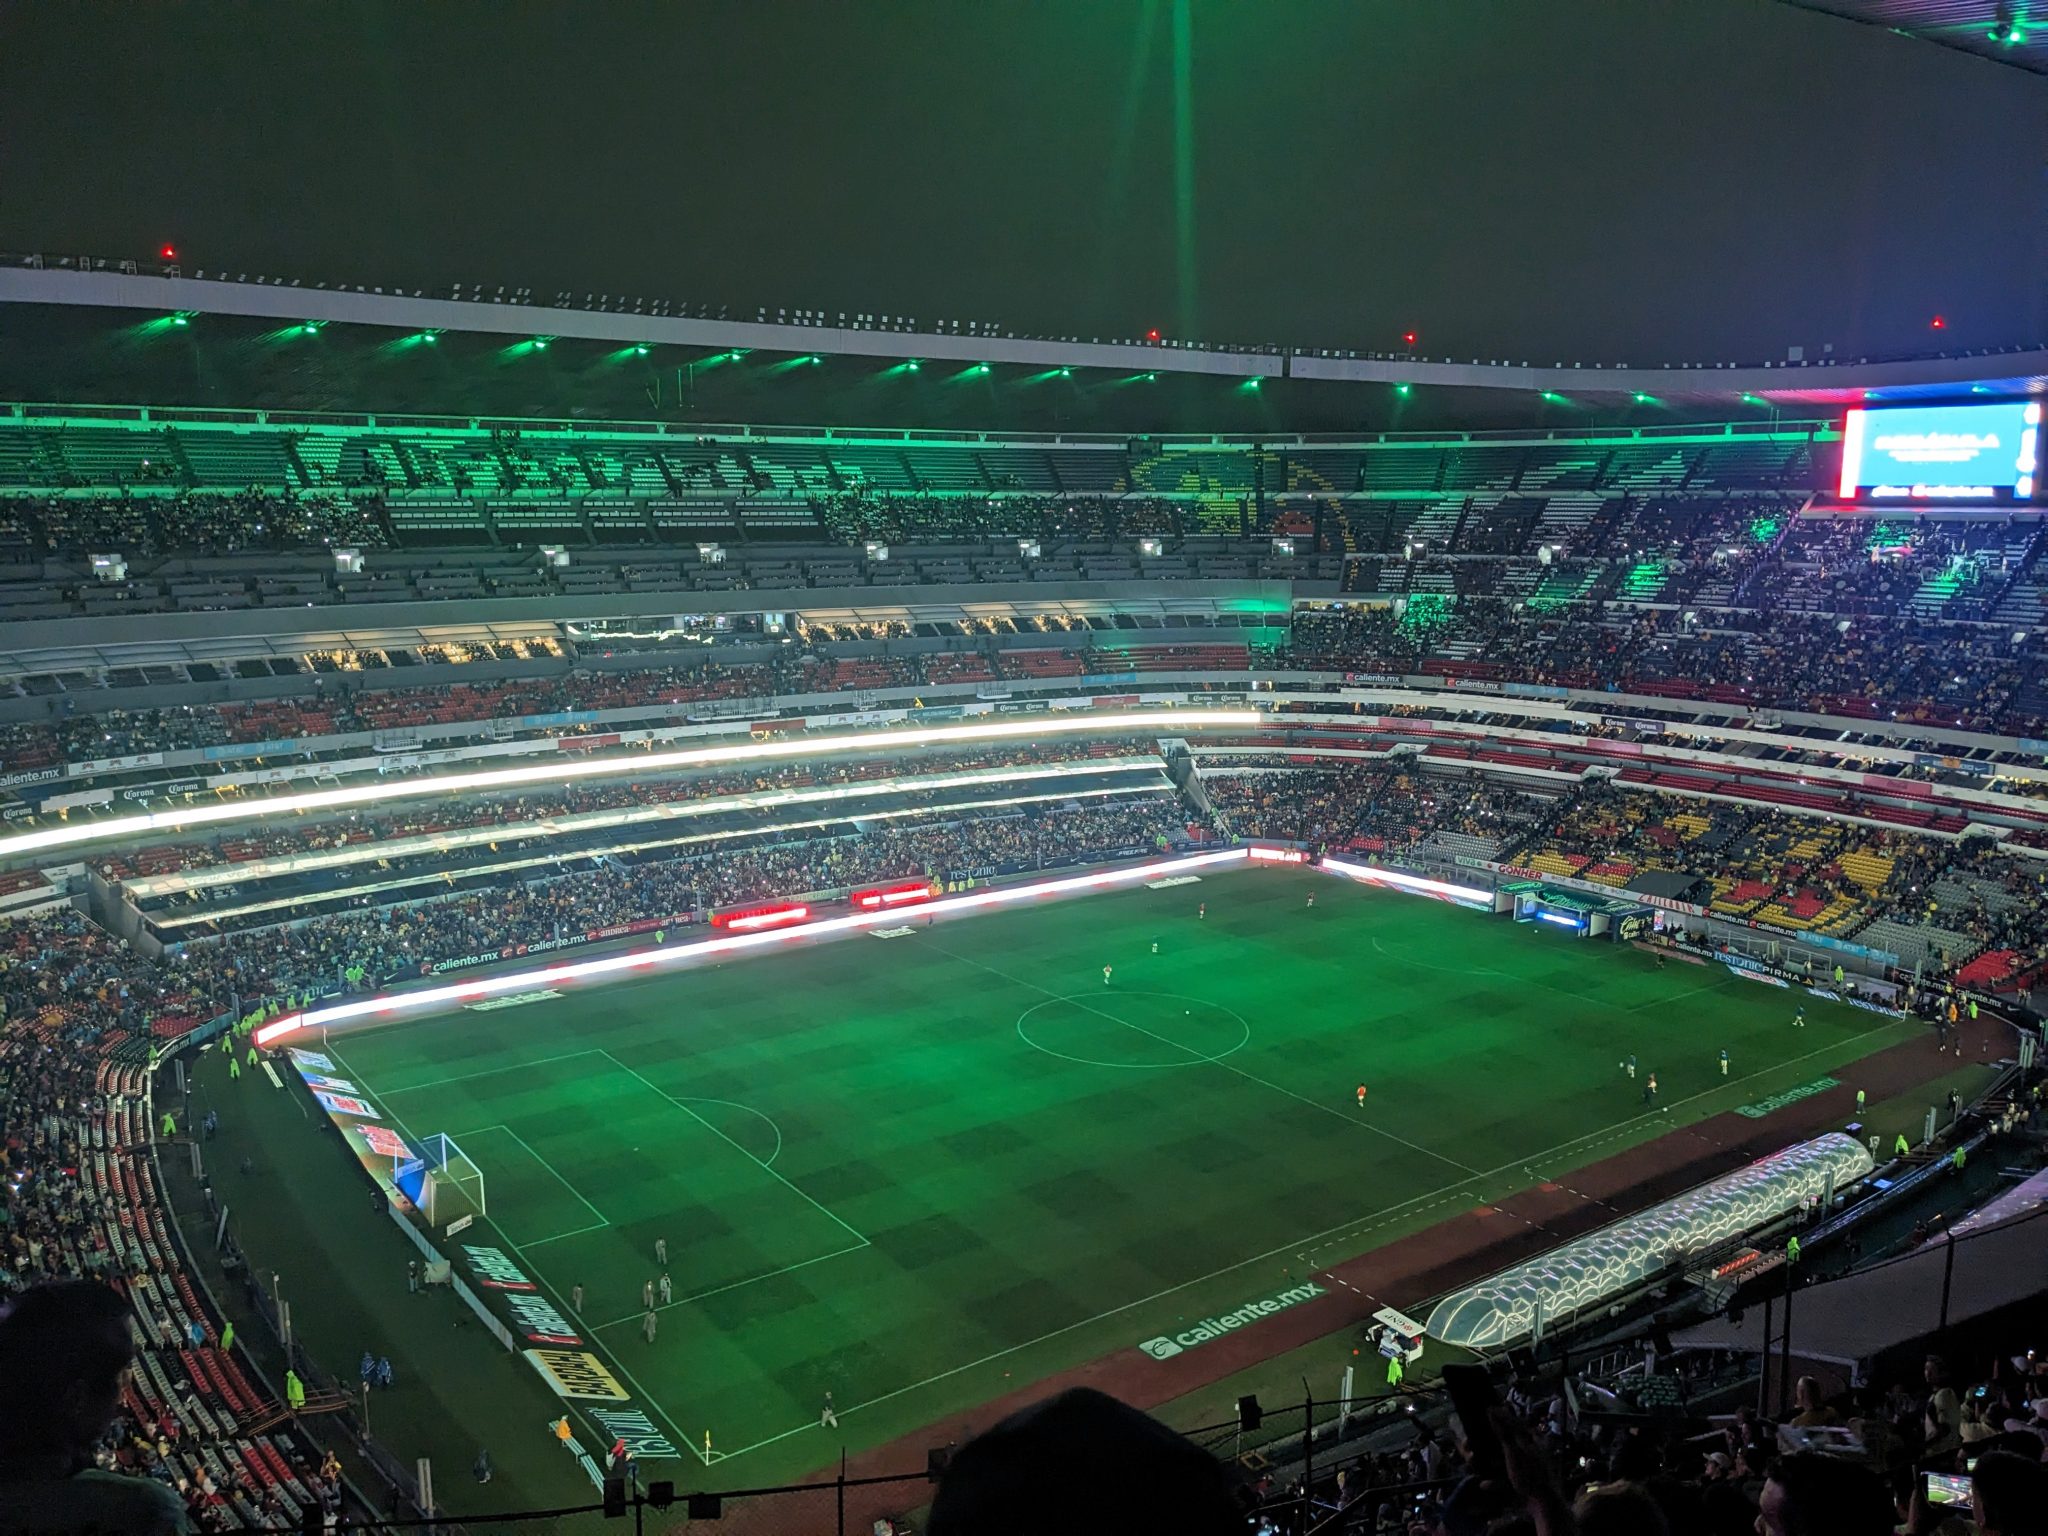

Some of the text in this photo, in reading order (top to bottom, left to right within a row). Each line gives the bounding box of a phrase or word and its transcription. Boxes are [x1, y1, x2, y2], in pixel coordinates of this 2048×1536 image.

[1354, 673, 1400, 683] caliente.mx
[1455, 679, 1499, 690] caliente.mx
[1193, 693, 1241, 702] Corona Corona
[999, 702, 1044, 712] Corona Corona
[1605, 718, 1657, 730] Corona Corona
[0, 769, 60, 787] aliente.mx
[123, 783, 198, 800] Corona Corona
[3, 807, 33, 820] Corona
[1498, 864, 1543, 880] GONHER
[1709, 911, 1749, 926] caliente.mx
[1756, 922, 1797, 937] caliente.mx
[1675, 941, 1713, 958] caliente.mx
[432, 951, 498, 973] caliente.mx
[1762, 966, 1800, 982] PIRMA
[1755, 1077, 1836, 1112] caliente.mx
[1175, 1282, 1327, 1347] caliente.mx
[538, 1351, 617, 1397] BARDAHL
